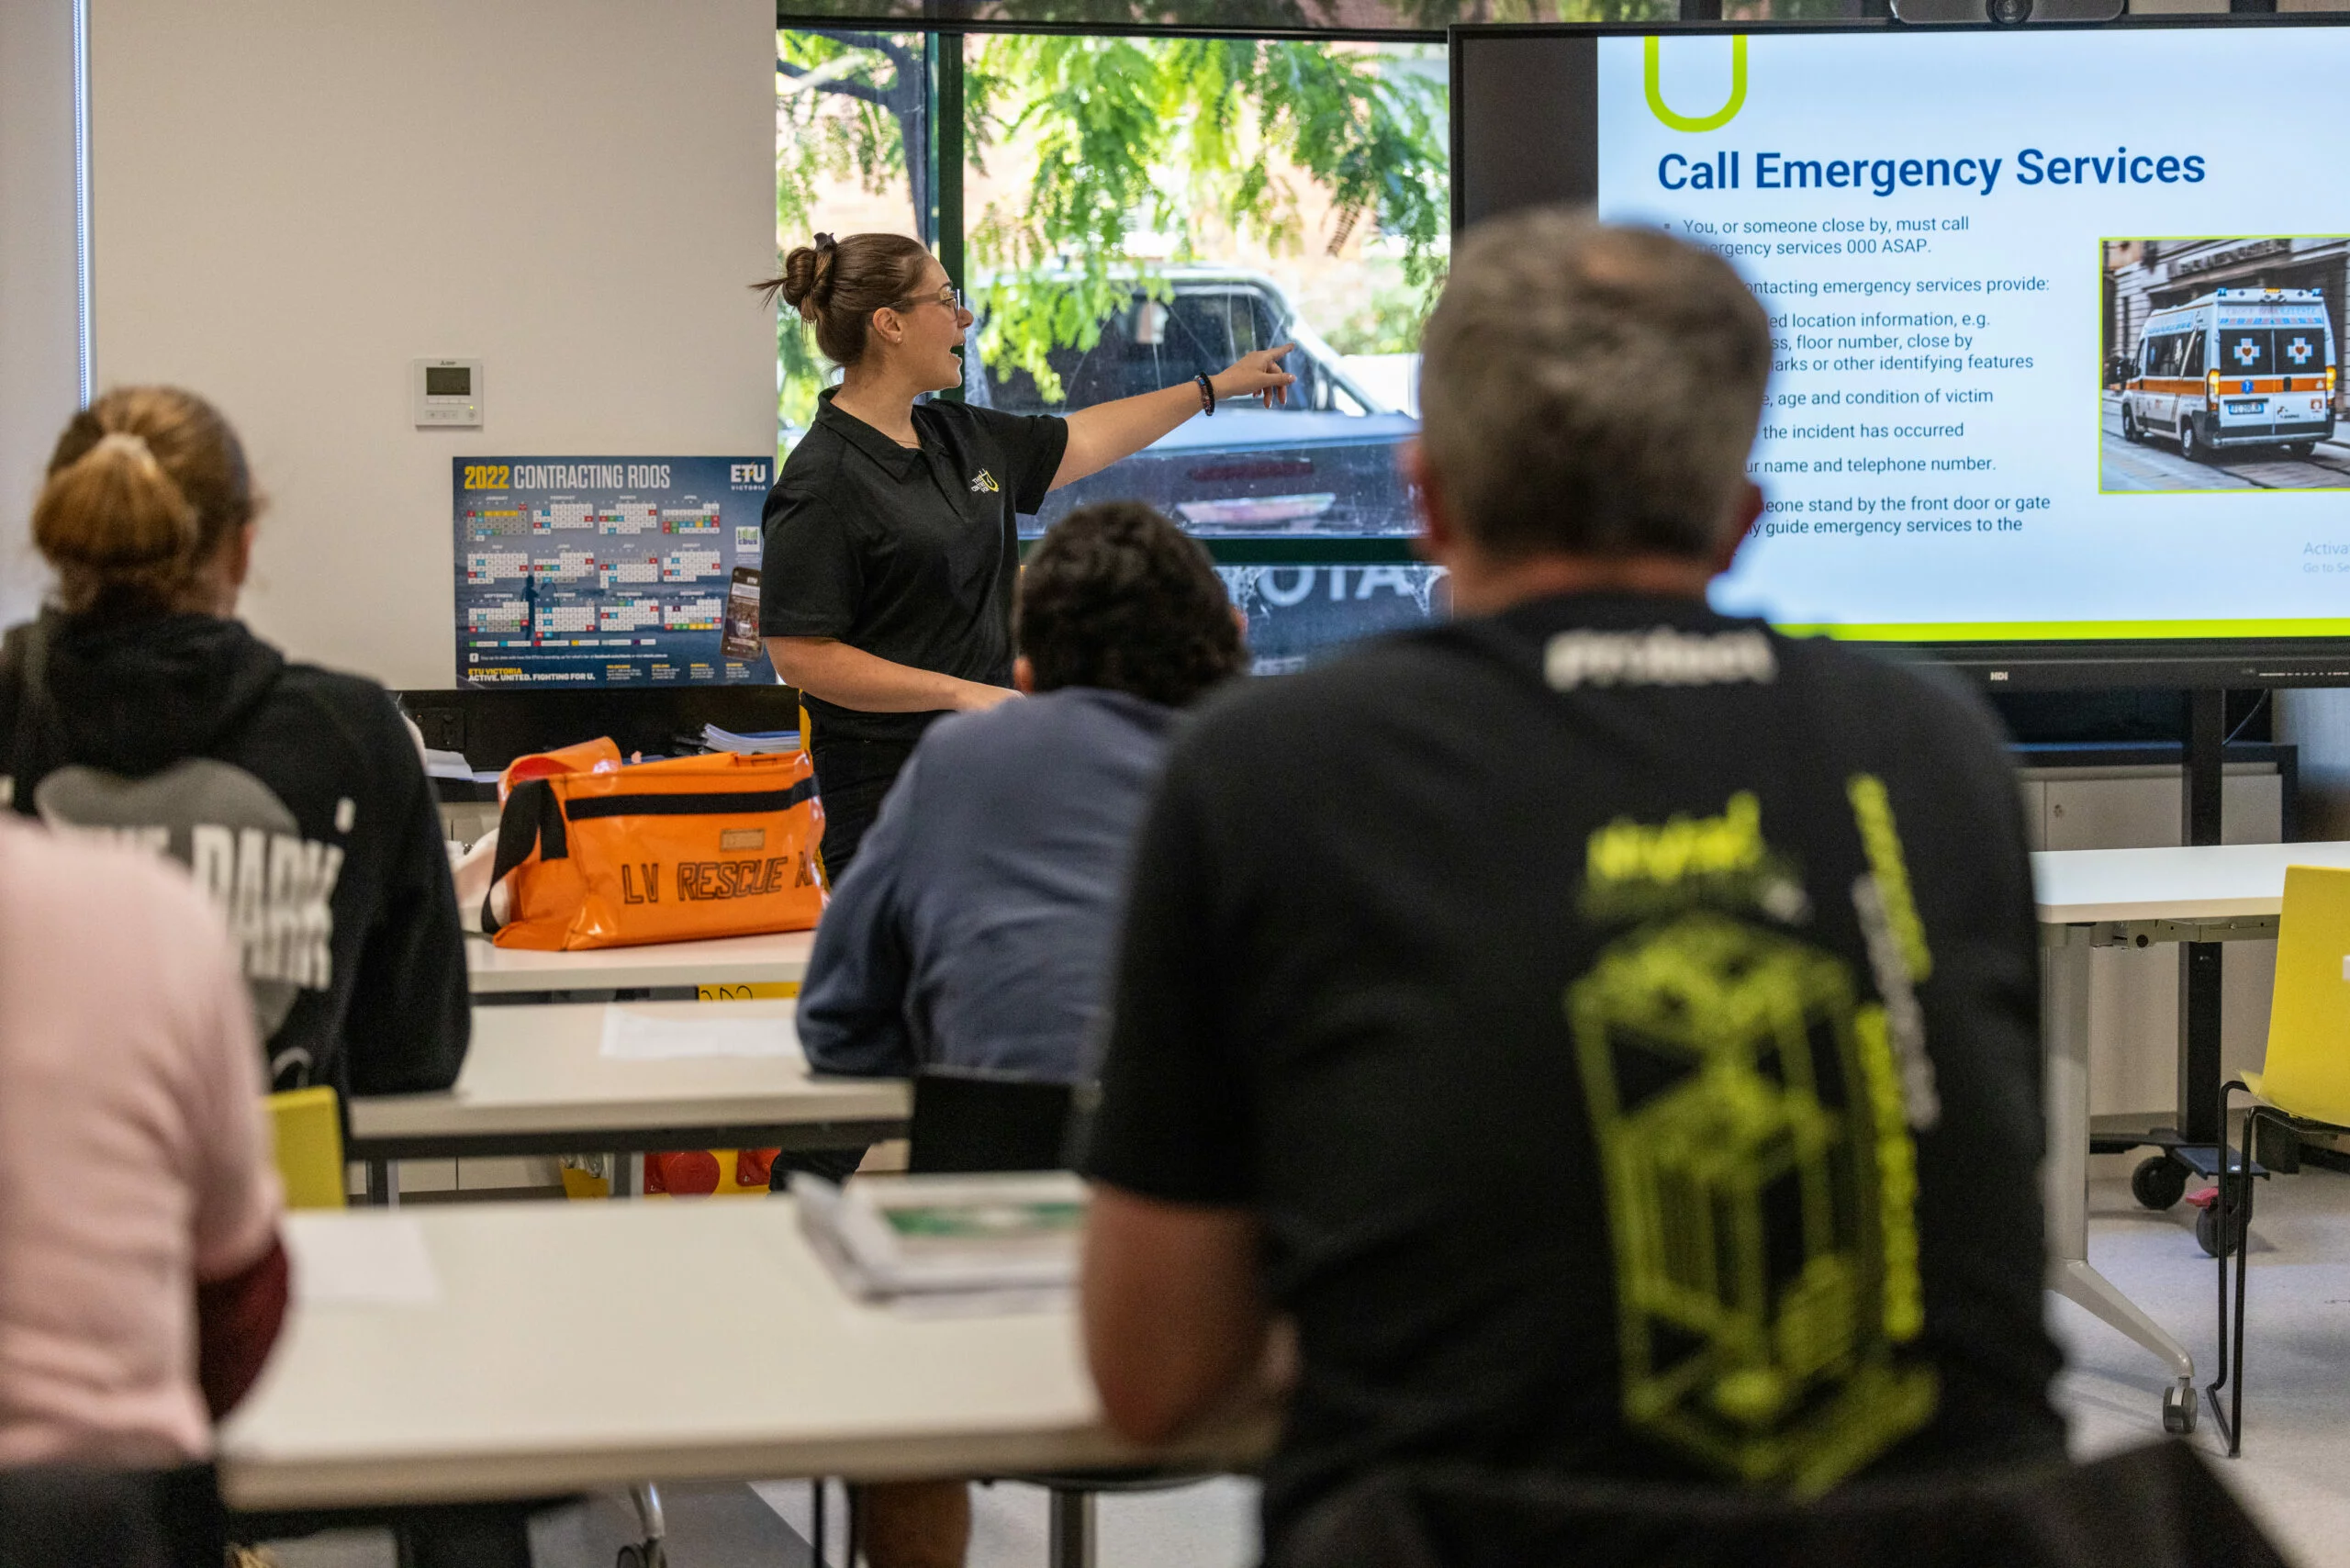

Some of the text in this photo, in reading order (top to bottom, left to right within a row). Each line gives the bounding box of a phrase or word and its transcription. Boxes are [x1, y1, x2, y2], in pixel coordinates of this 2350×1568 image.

[1659, 146, 2205, 197] Call Emergency Services
[1684, 216, 1968, 235] You, or someone close by, must call
[1696, 239, 1930, 258] ergency services 000 ASAP.
[1744, 275, 2049, 297] ontacting emergency services provide:
[1793, 313, 1855, 328] location
[1862, 311, 1957, 329] information,
[1962, 313, 1990, 329] e.g.
[1797, 334, 1833, 350] floor
[1839, 333, 1902, 350] number,
[1908, 333, 1949, 348] close
[1955, 332, 1973, 351] by
[1813, 359, 1829, 370] or
[1834, 356, 1874, 370] other
[1880, 354, 1962, 374] identifying
[1968, 353, 2033, 368] features
[1778, 394, 1806, 409] age
[1812, 390, 1840, 405] and
[1846, 389, 1919, 405] condition
[1925, 388, 1941, 404] of
[1946, 389, 1993, 403] victim
[1762, 421, 1964, 440] the incident has occurred
[731, 464, 766, 483] ETU
[1765, 461, 1808, 473] name
[1814, 458, 1842, 472] and
[1848, 457, 1926, 476] telephone
[1931, 456, 1996, 471] number.
[464, 465, 670, 489] 2022 CONTRACTING RDOS
[1765, 495, 2050, 515] eone stand by the front door or gate
[1766, 520, 1808, 538] guide
[1814, 521, 1901, 537] emergency
[1907, 518, 1972, 532] services
[1976, 519, 1992, 532] to
[1998, 516, 2022, 532] the
[2303, 540, 2350, 554] Activa
[2303, 563, 2320, 573] Go
[2322, 563, 2333, 572] to
[468, 674, 499, 682] ACTIVE.
[501, 673, 532, 681] UNITED.
[532, 673, 570, 681] FIGHTING
[570, 672, 586, 680] FOR
[621, 863, 659, 904] LV
[677, 857, 788, 901] RESCUE
